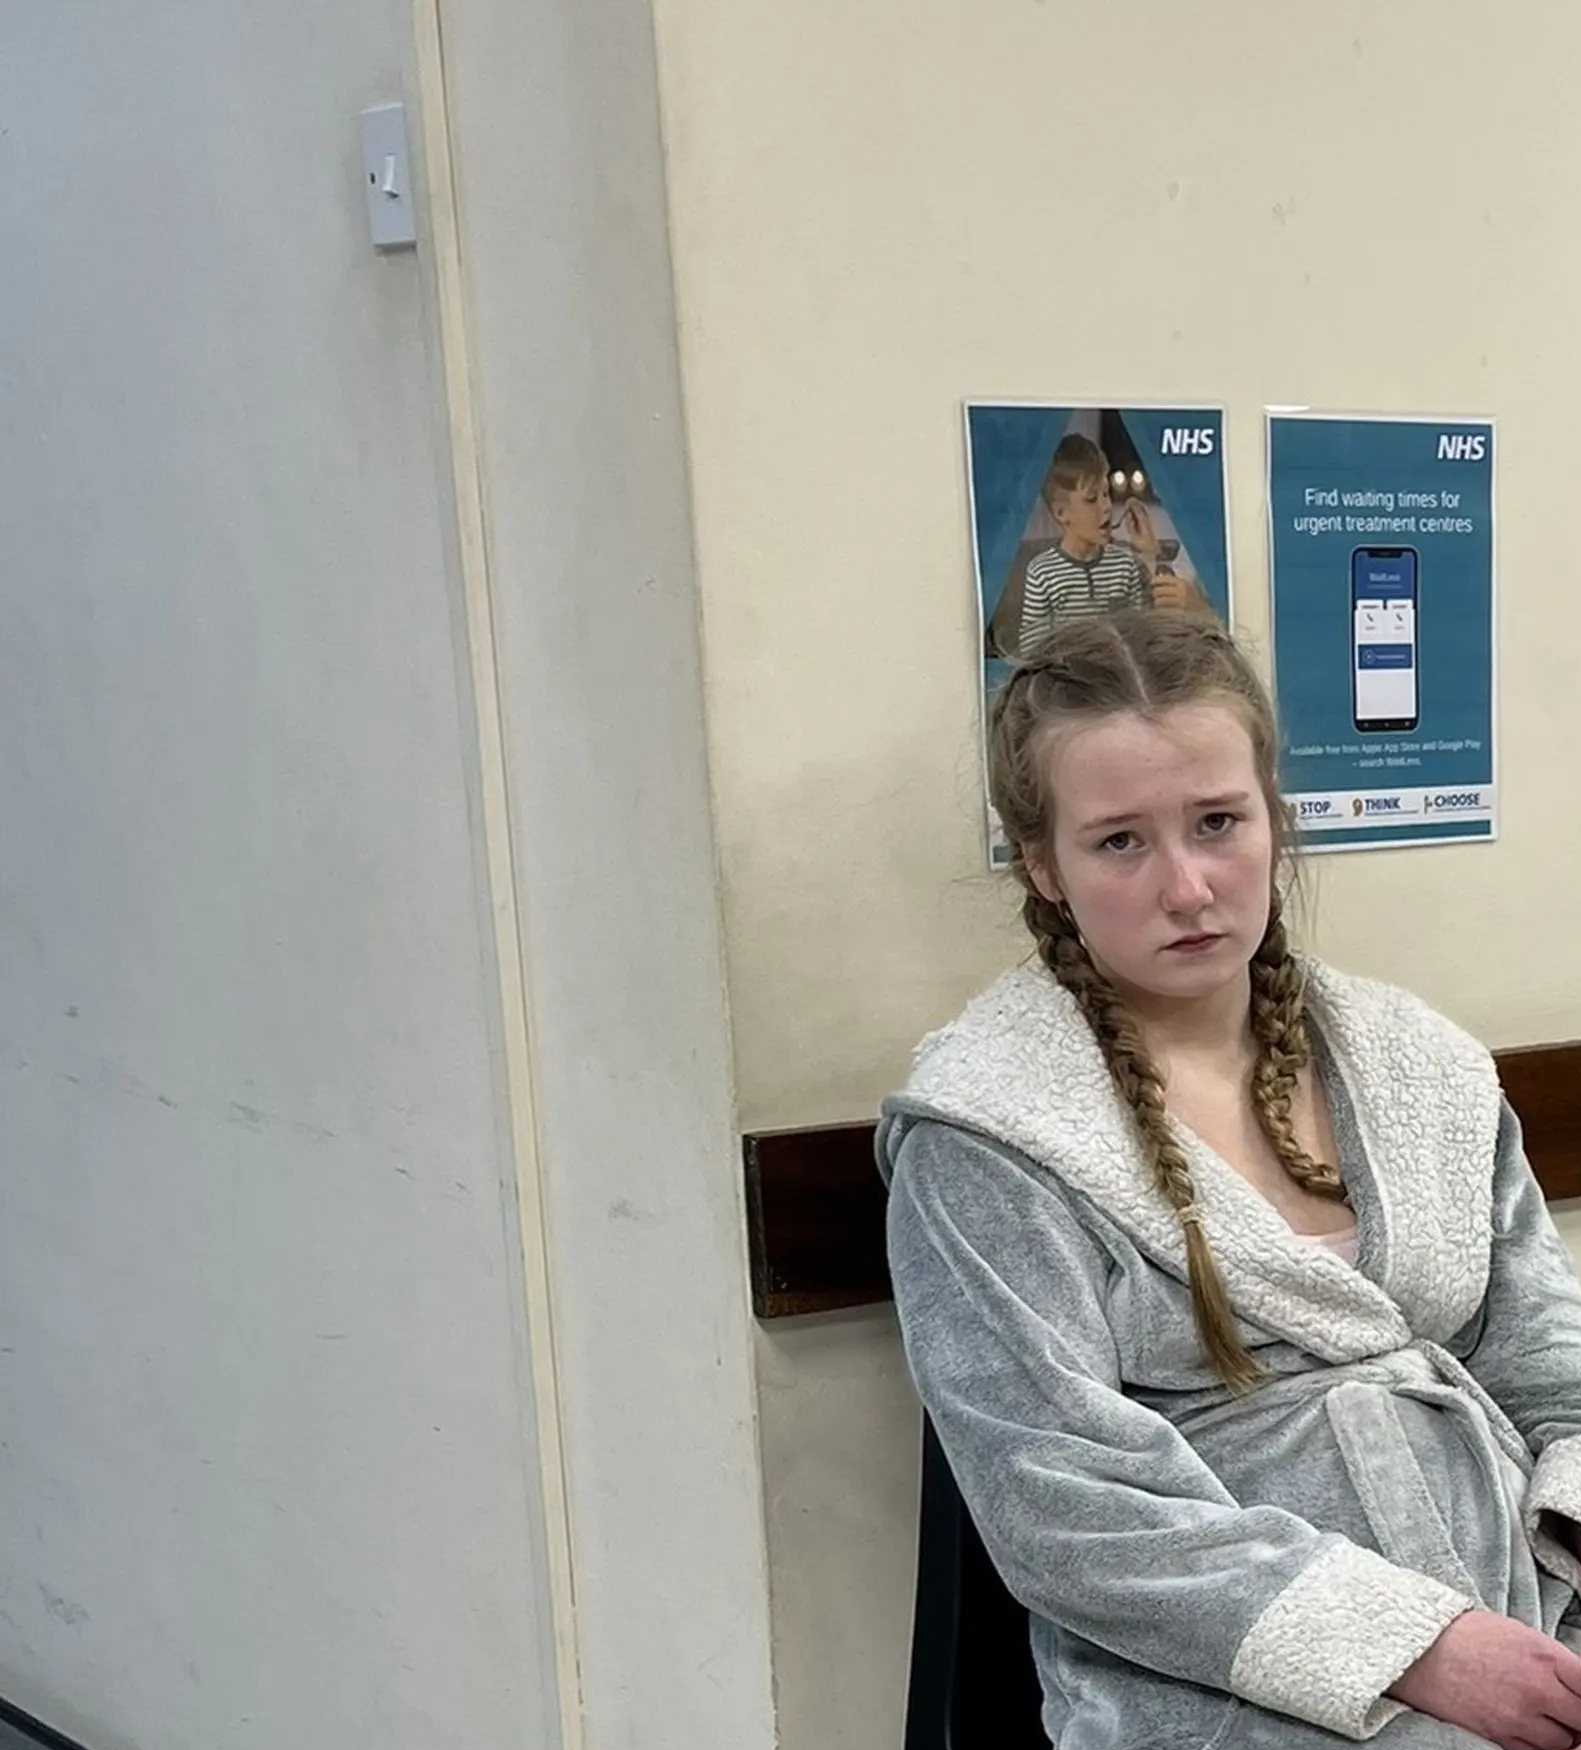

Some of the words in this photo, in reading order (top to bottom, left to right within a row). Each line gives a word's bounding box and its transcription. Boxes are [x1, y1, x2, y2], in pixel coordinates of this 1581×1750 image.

[1161, 429, 1214, 454] NHS
[1438, 435, 1485, 460] NHS
[1305, 488, 1337, 507] Find
[1342, 489, 1393, 512] waiting
[1398, 490, 1437, 507] times
[1440, 490, 1460, 508] for
[1294, 516, 1342, 535] urgent
[1345, 516, 1416, 532] treatment
[1420, 517, 1473, 533] centres
[1300, 801, 1332, 814] STOP
[1365, 798, 1401, 811] THINK
[1434, 793, 1480, 807] CHOOSE
